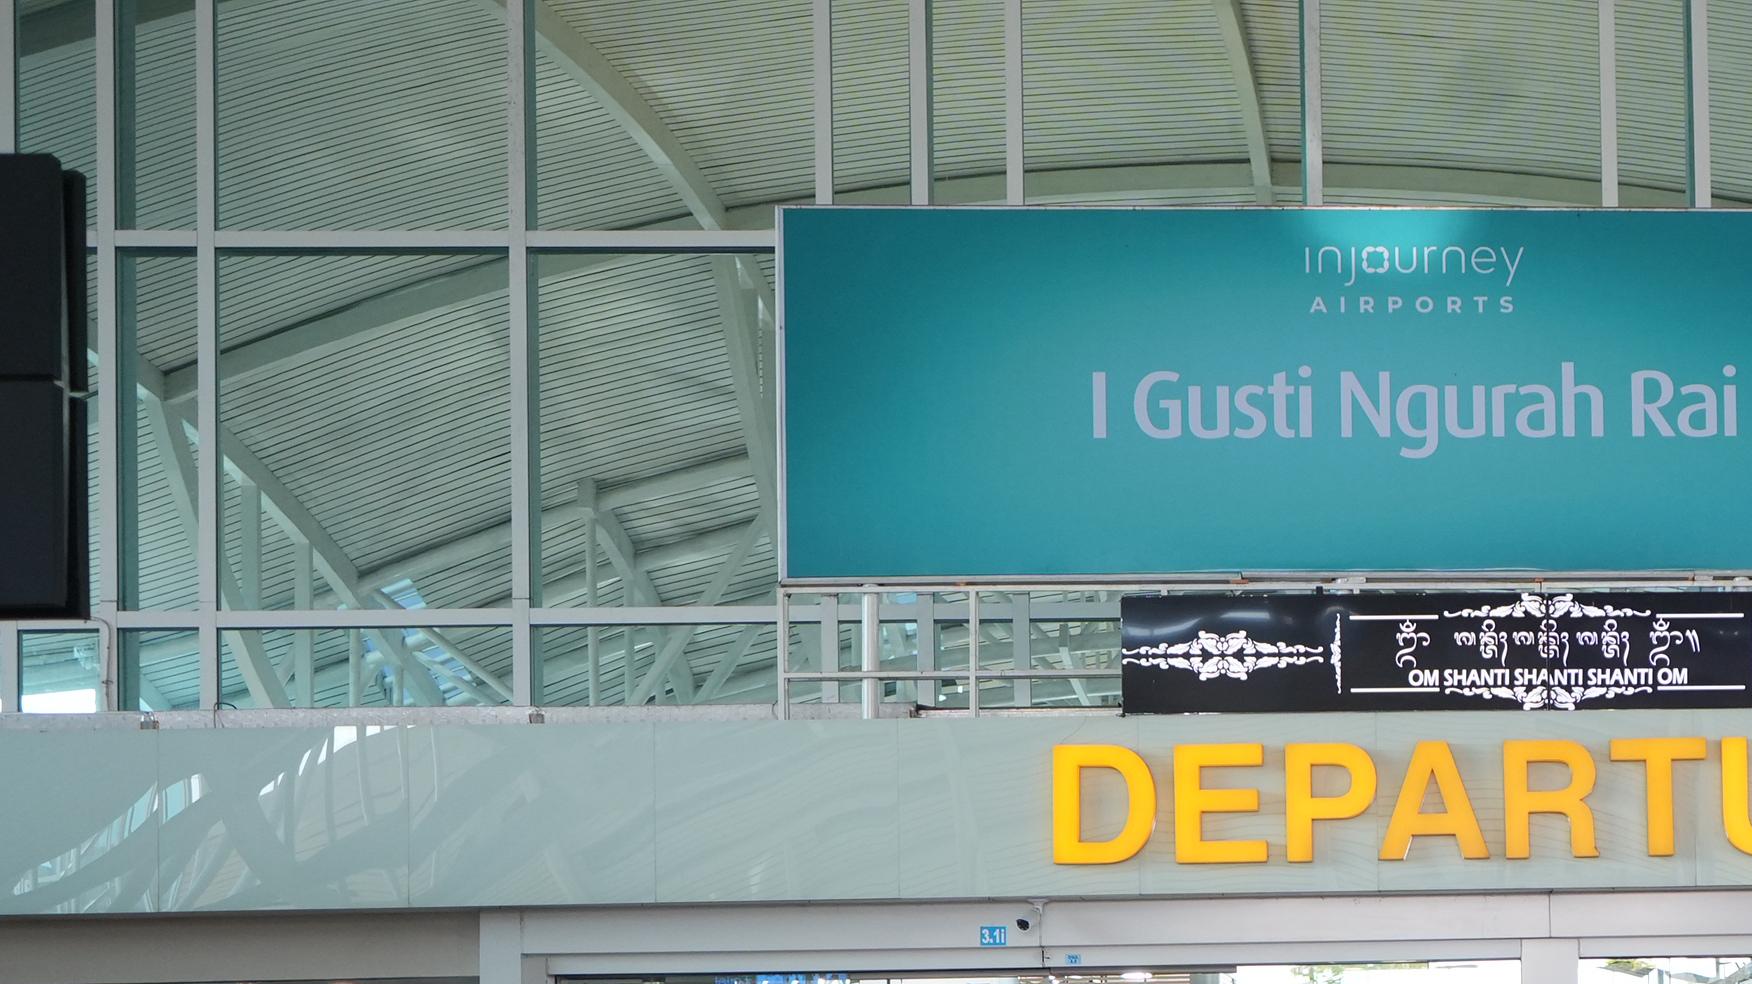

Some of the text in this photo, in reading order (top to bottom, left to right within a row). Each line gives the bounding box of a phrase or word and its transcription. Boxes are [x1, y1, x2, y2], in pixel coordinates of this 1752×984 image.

[1304, 246, 1525, 287] injourney
[1309, 296, 1514, 313] AIRPORTS
[1091, 361, 1738, 460] I Gusti Ngurah Rai
[1408, 667, 1688, 687] OM SHANTI SHANTI SHANTI OM
[981, 928, 1006, 944] 3.1i
